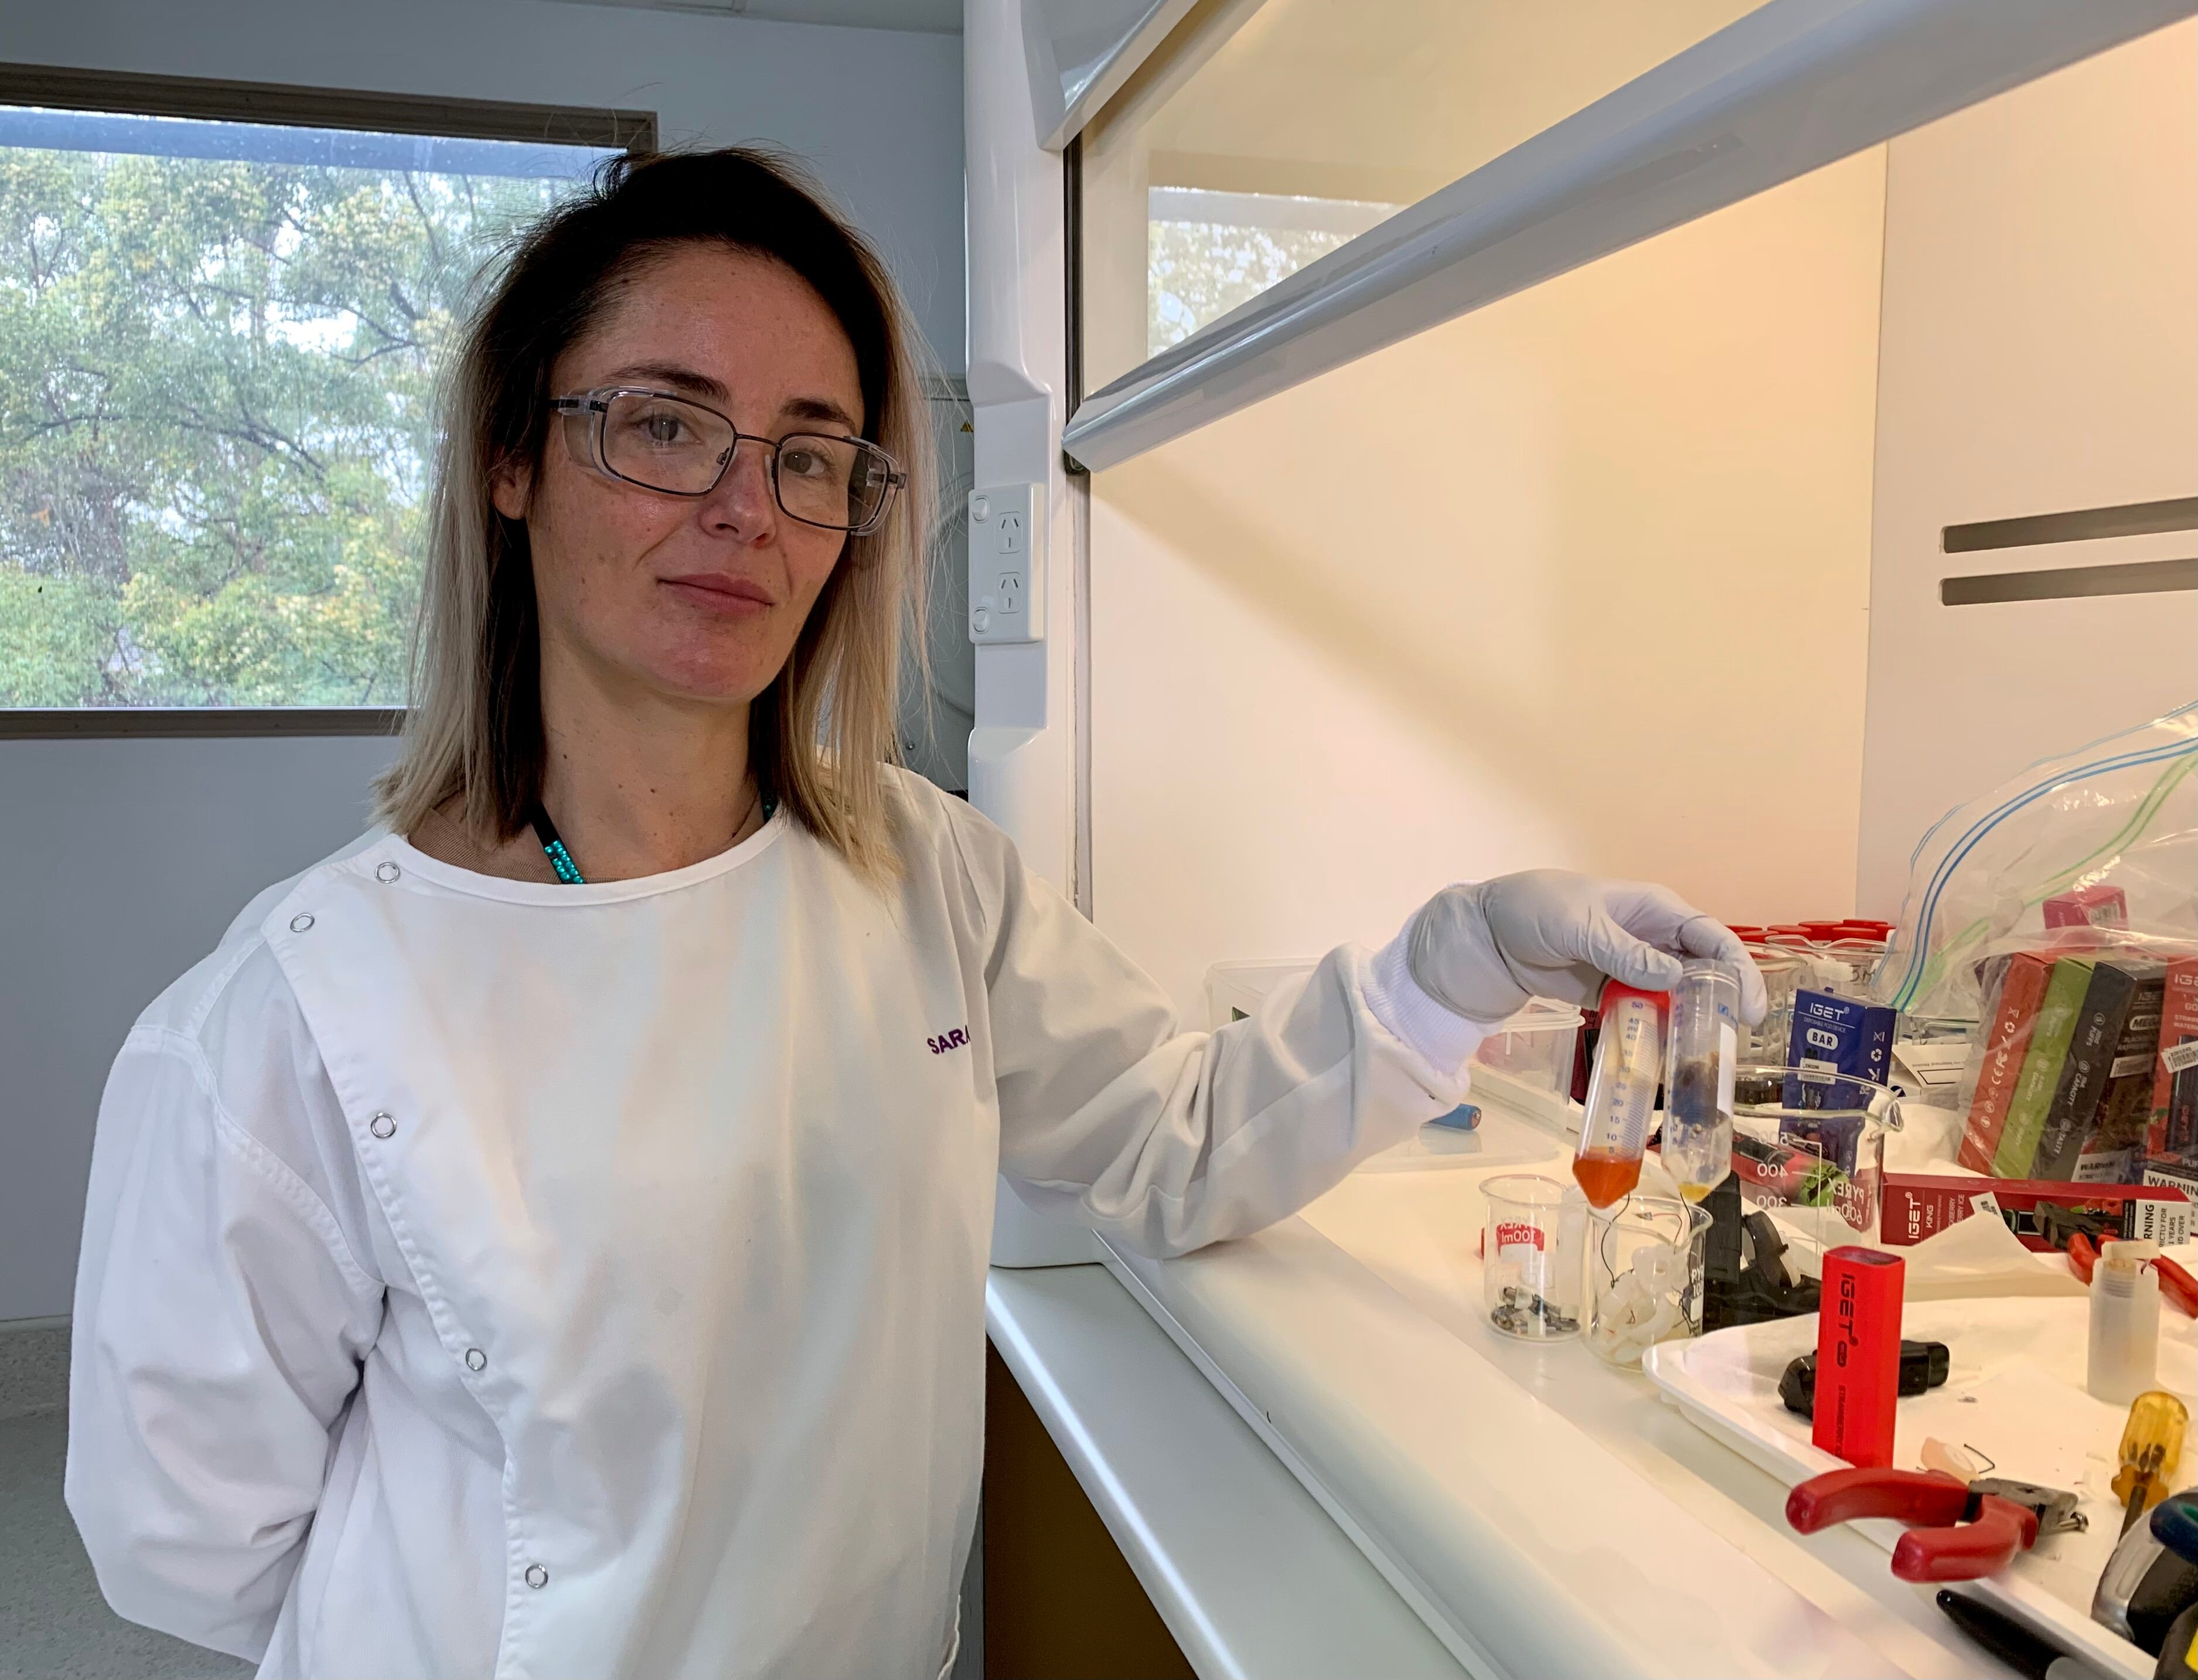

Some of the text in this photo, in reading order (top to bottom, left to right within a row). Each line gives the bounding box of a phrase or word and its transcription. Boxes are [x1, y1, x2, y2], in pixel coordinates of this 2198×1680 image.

[2185, 1003, 2198, 1011] GO
[1812, 1031, 1833, 1047] BAR
[2068, 1073, 2083, 1106] CAPACITY
[1610, 1115, 1620, 1124] 15
[2054, 1134, 2066, 1154] TASTY
[2148, 1175, 2198, 1197] WARNIN
[1926, 1205, 1934, 1229] KING
[1947, 1198, 1956, 1226] CKBERRY
[2144, 1204, 2155, 1239] RNING
